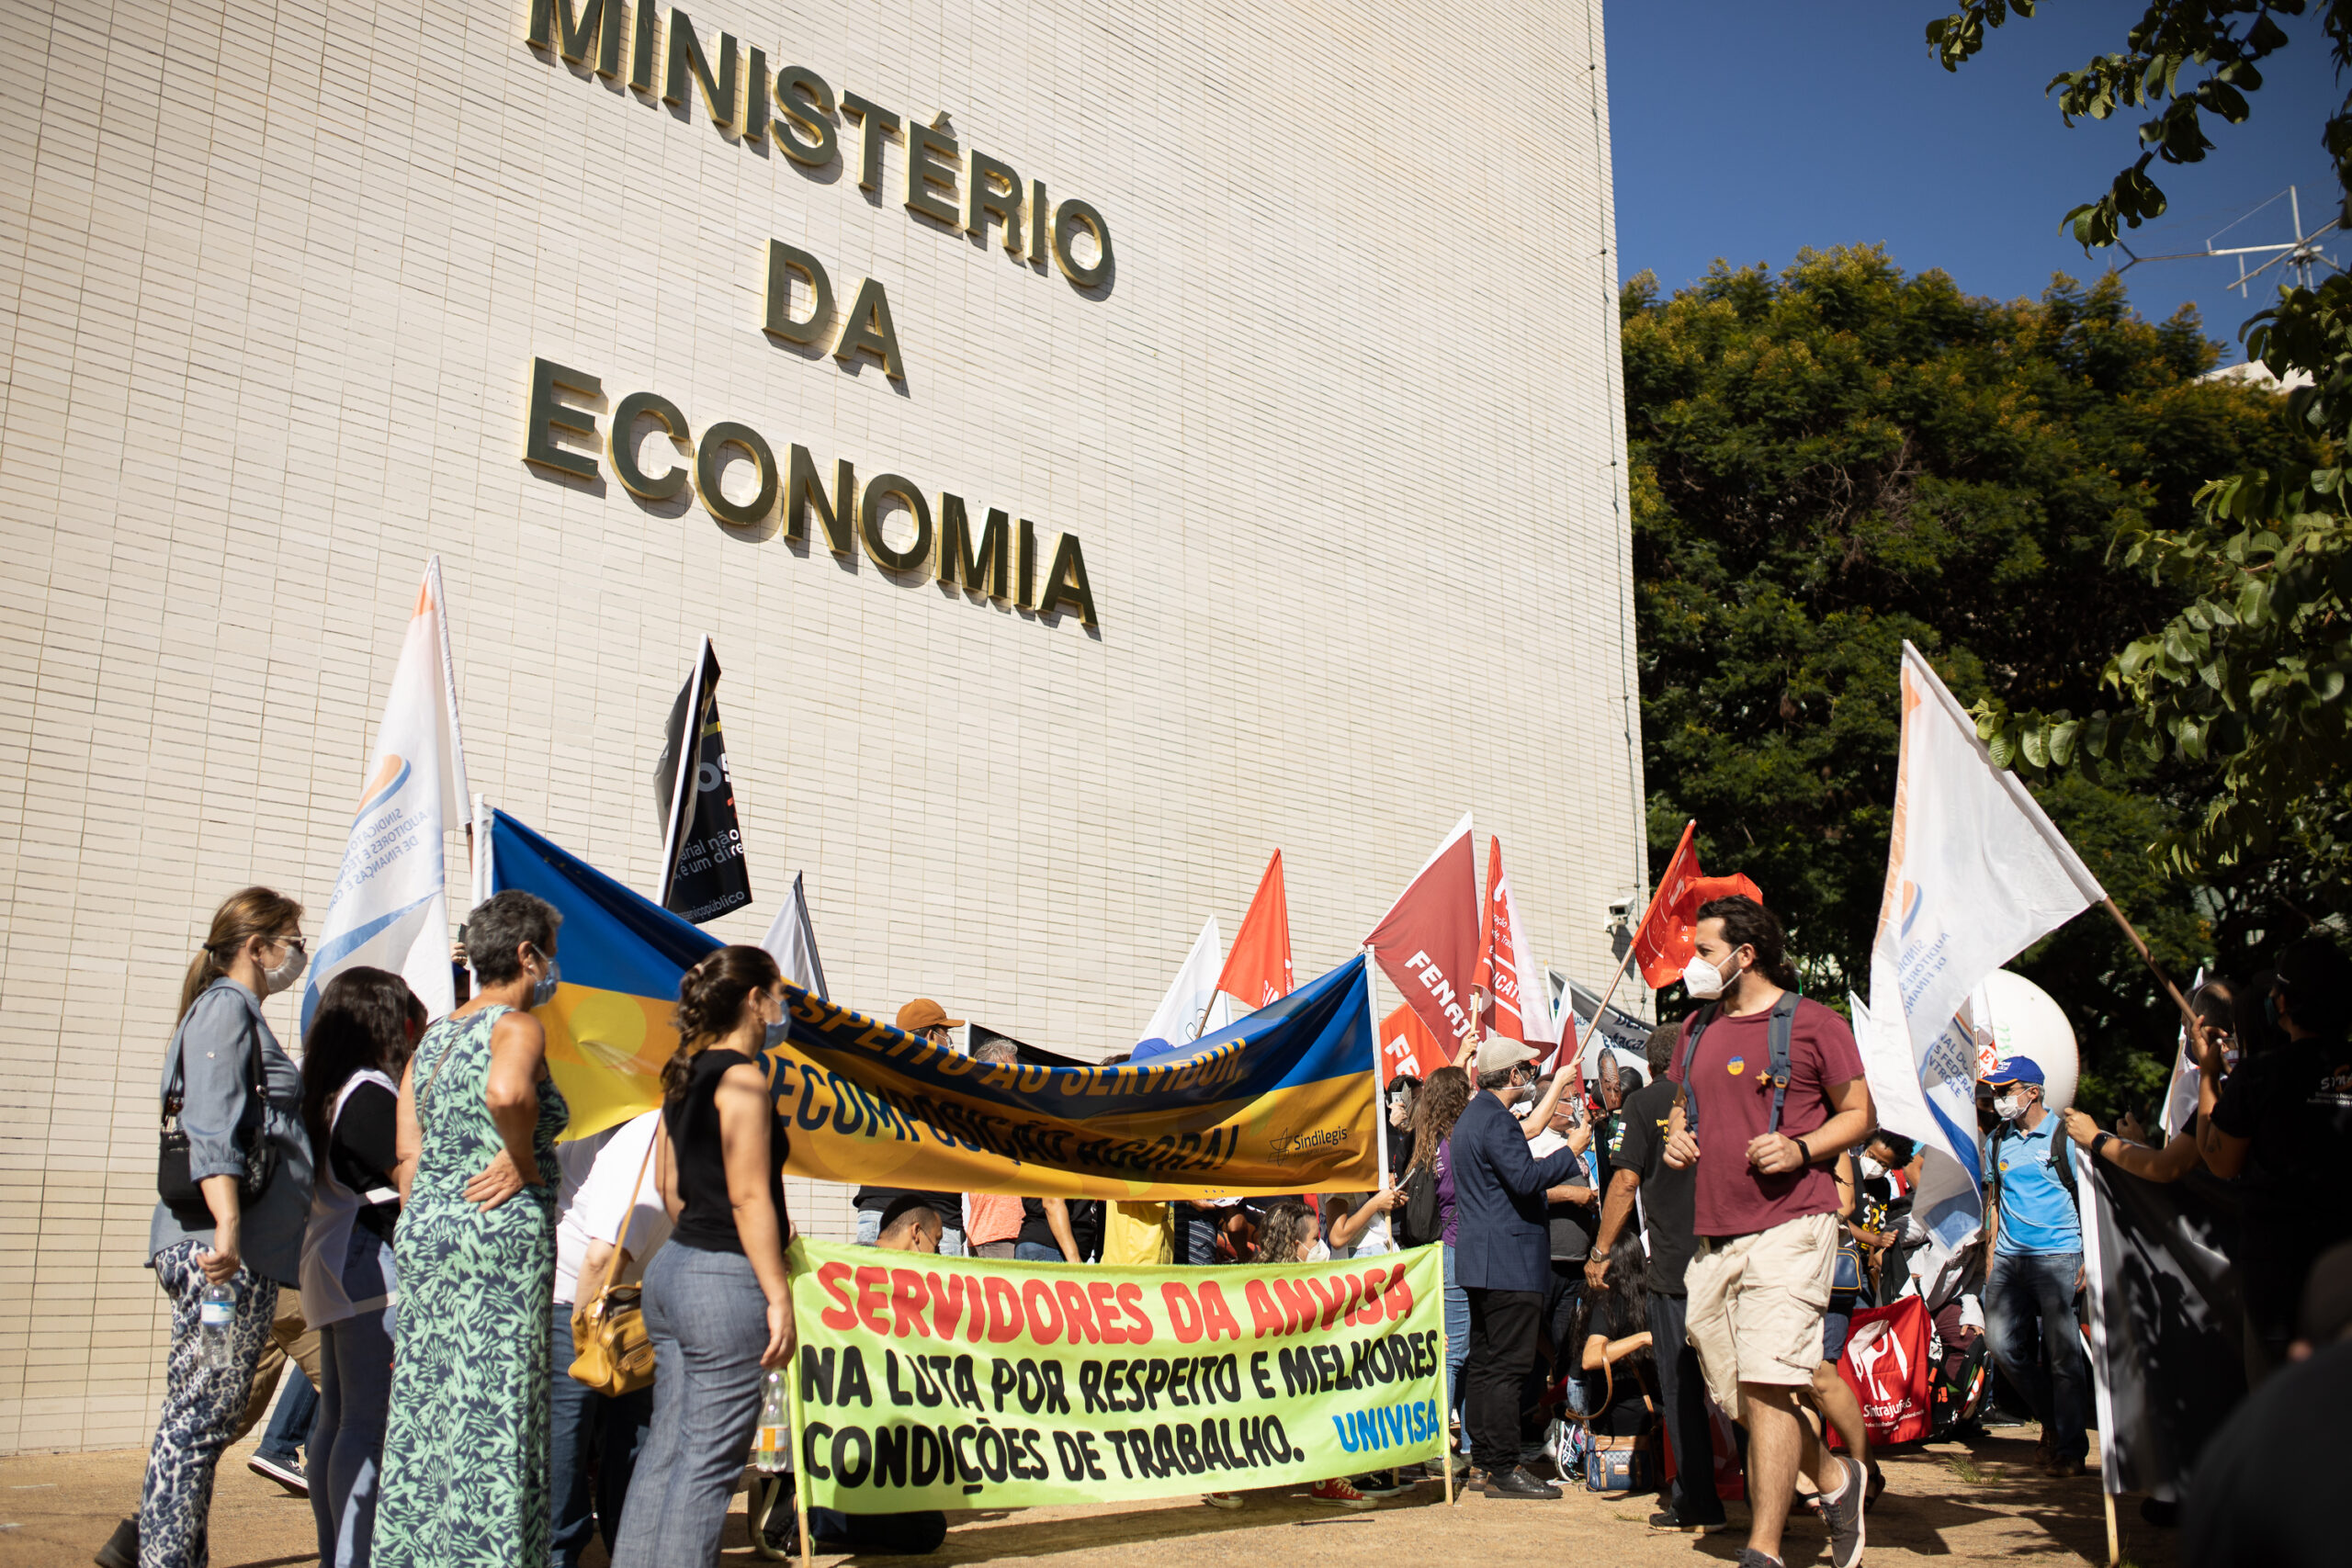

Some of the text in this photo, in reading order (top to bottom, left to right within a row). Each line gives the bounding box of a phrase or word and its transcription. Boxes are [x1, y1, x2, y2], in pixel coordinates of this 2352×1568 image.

[525, 0, 1113, 287] MINISTÉRIO
[761, 237, 905, 381] DA
[522, 355, 1099, 628] ECONOMIA
[680, 829, 740, 862] arial não
[689, 856, 712, 874] um
[1404, 949, 1472, 1038] FENAJ
[1078, 1124, 1240, 1171] AGORA!
[1294, 1125, 1348, 1151] Sindilegis
[820, 1259, 1415, 1346] SERVIDORES DA ANVISA
[801, 1328, 1439, 1416] NA LUTA POR RESPEITO E MELHORES
[802, 1398, 1442, 1495] CONDIÇÕES DE TRABALHO. UNIVISA
